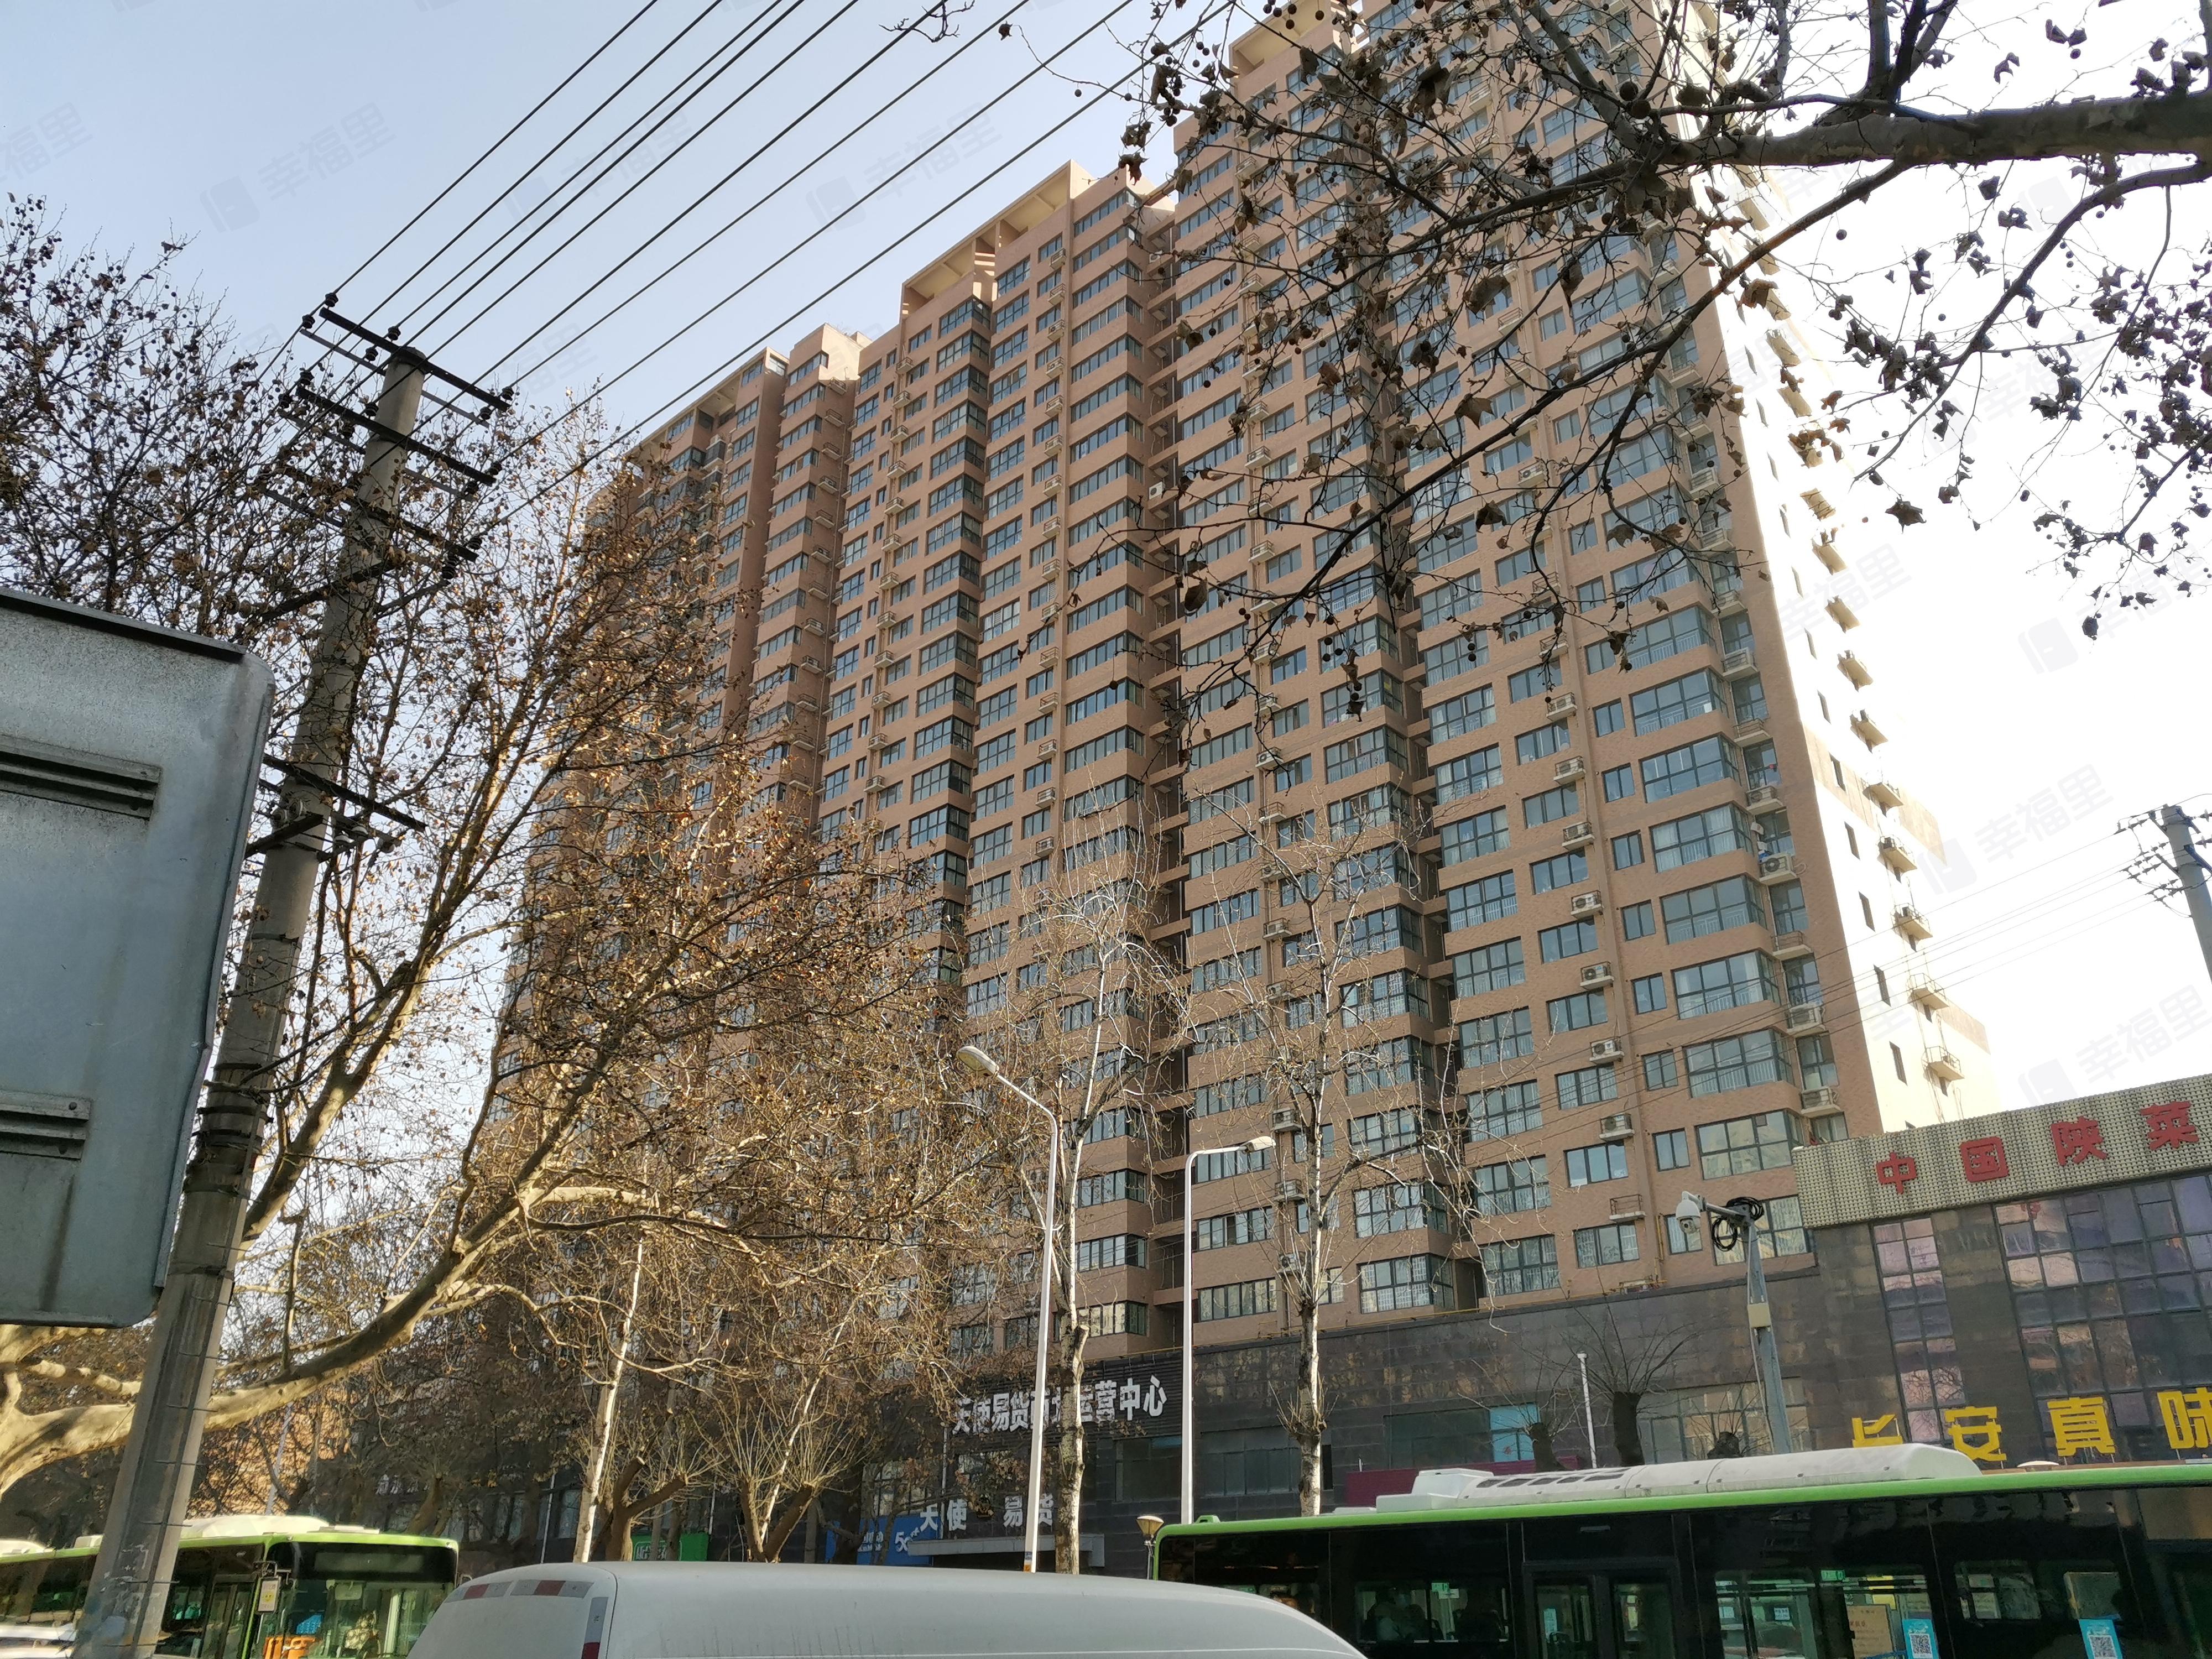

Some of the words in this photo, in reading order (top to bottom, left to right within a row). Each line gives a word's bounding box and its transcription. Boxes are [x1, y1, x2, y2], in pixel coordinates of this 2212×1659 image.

[1875, 1100, 2199, 1194] 中国陕菜
[1851, 1386, 2212, 1462] 长安真味
